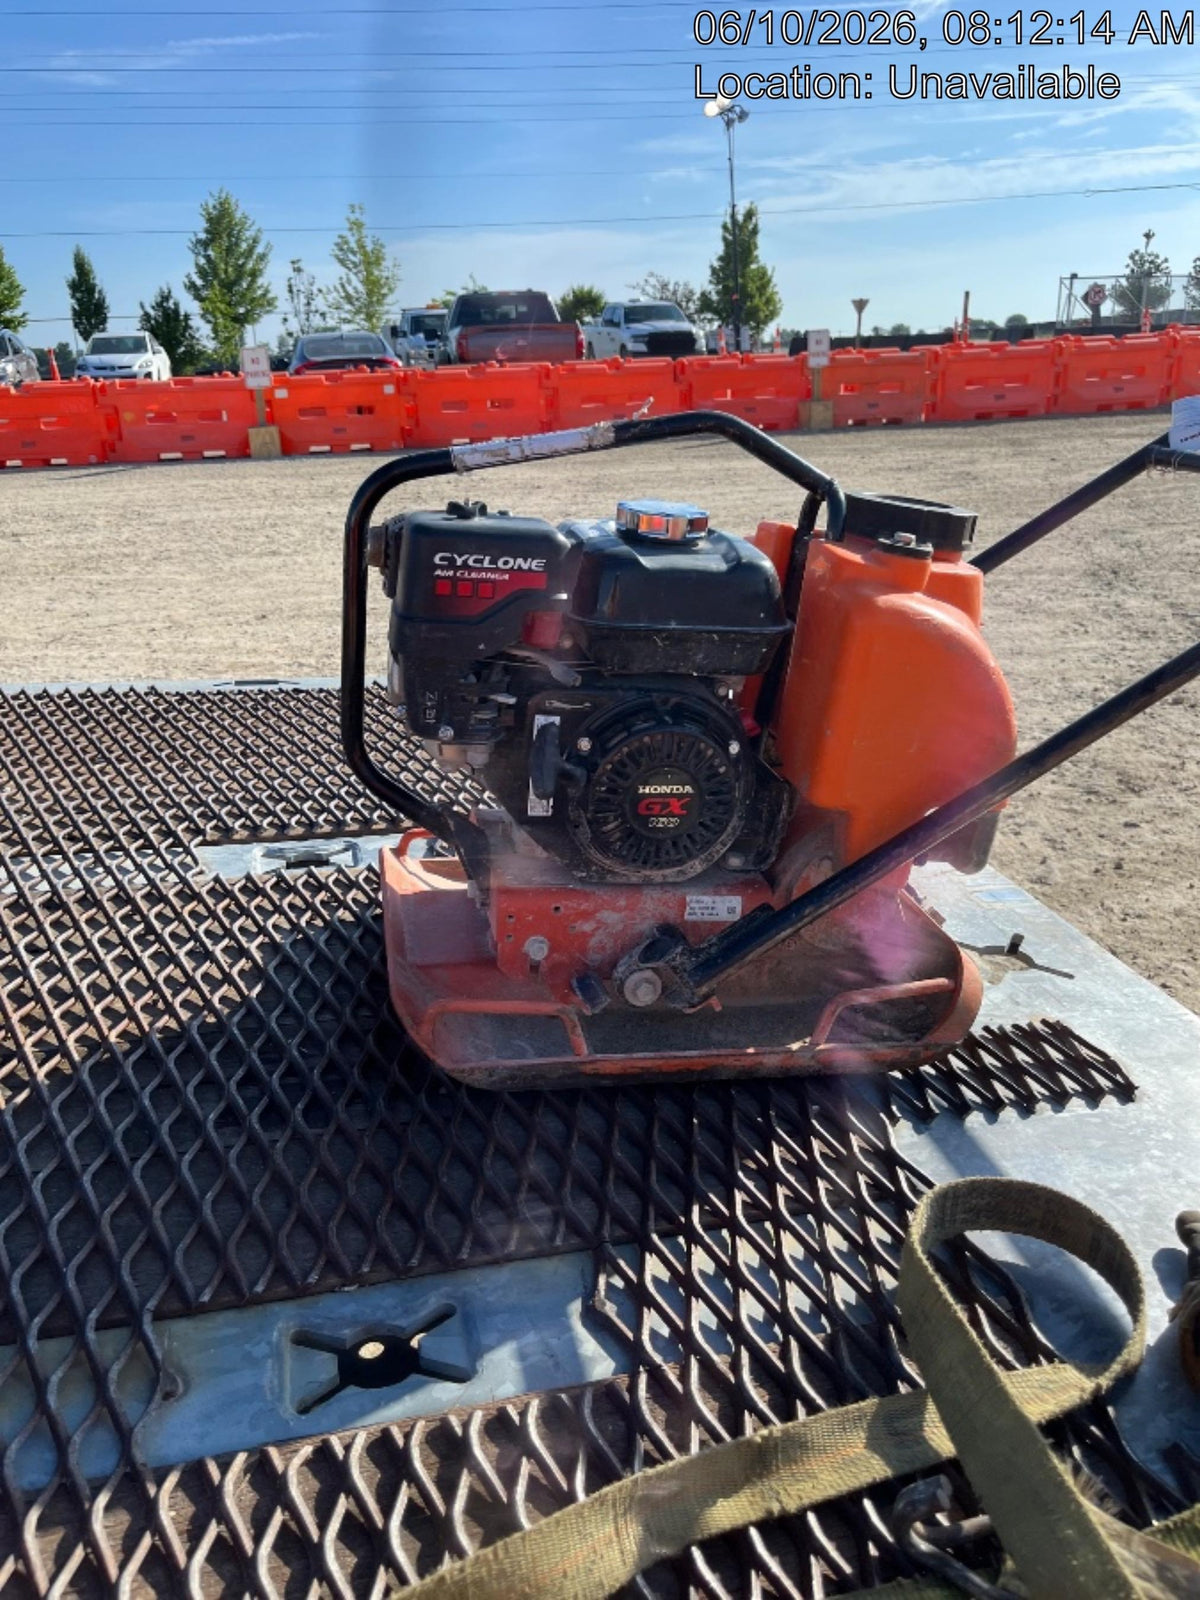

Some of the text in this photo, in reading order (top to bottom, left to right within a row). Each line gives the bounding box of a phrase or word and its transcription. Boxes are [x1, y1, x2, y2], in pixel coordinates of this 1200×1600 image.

[433, 552, 547, 571] CYCLONE
[638, 785, 695, 794] HONDA
[638, 797, 691, 816] GX
